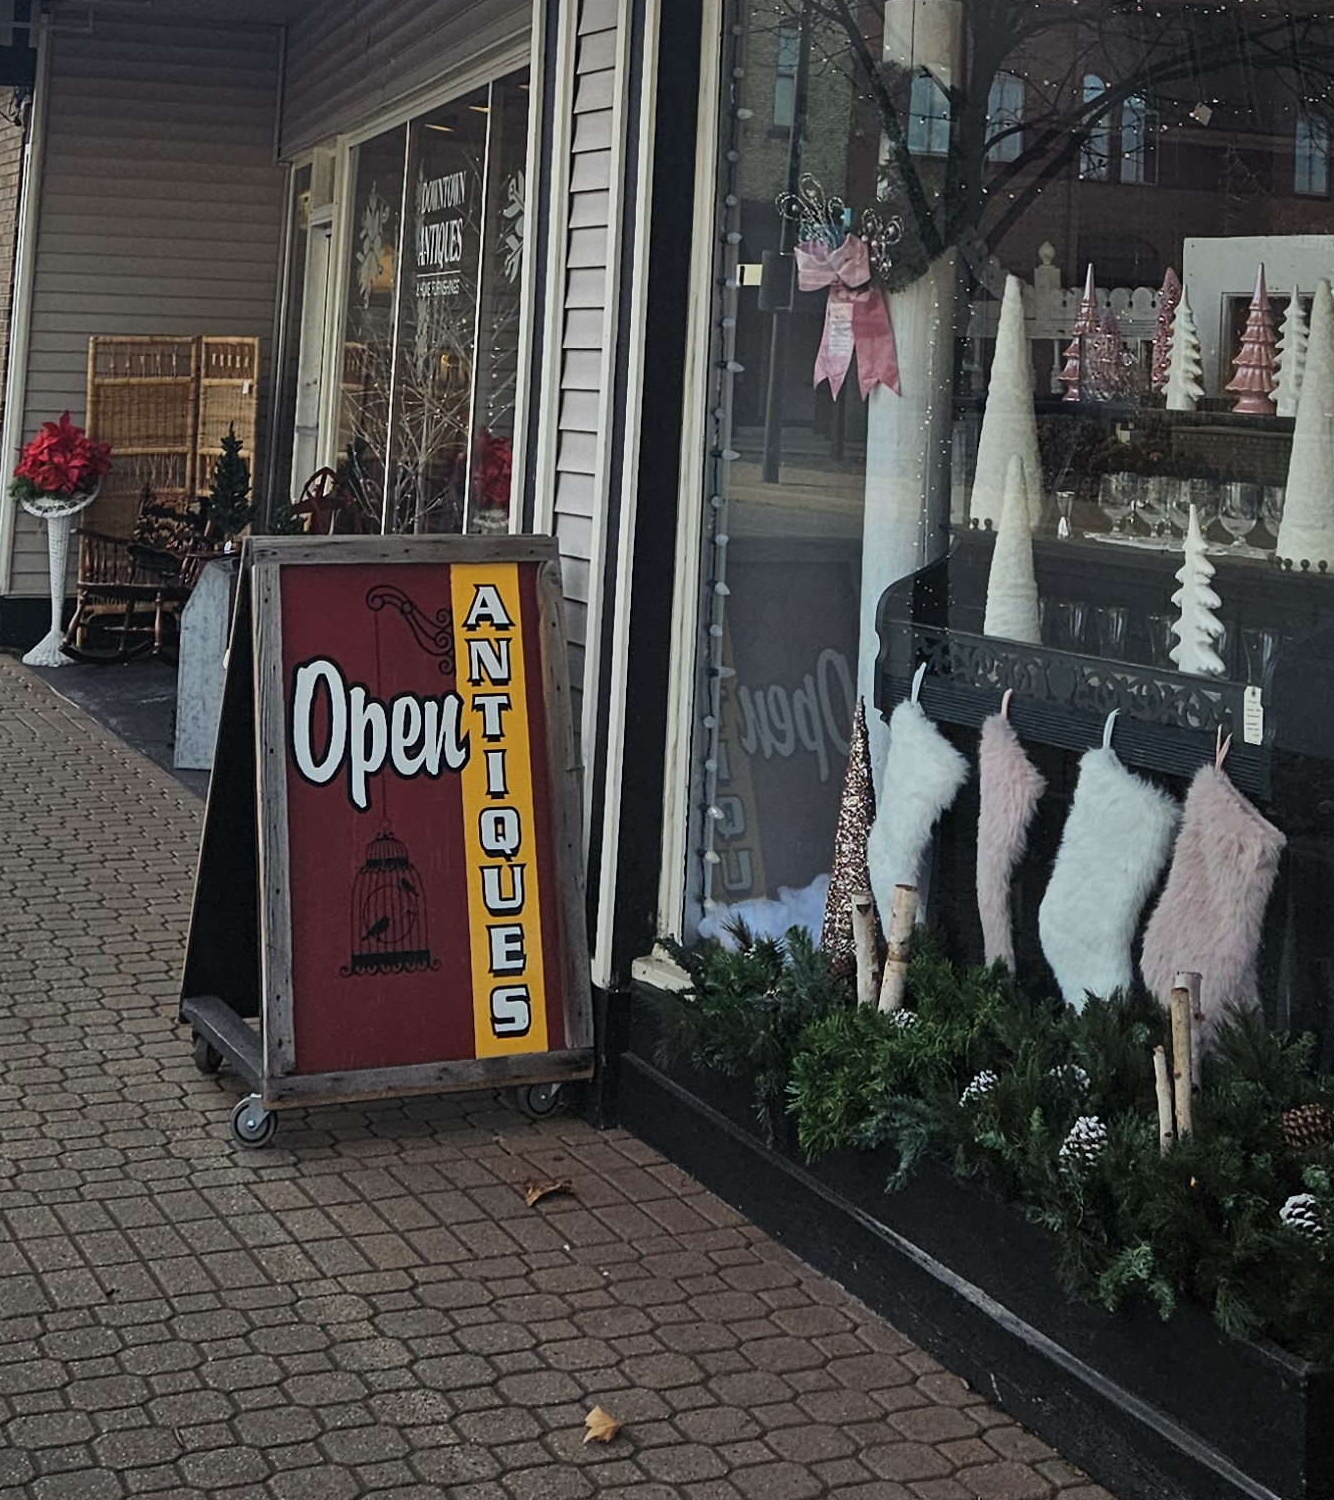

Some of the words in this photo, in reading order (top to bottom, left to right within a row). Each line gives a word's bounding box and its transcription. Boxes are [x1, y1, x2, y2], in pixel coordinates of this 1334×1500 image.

[421, 171, 467, 215] DOWNTOWN
[417, 218, 464, 269] ANTIQUES
[292, 659, 468, 809] Open
[463, 583, 532, 1038] ANTIQUES
